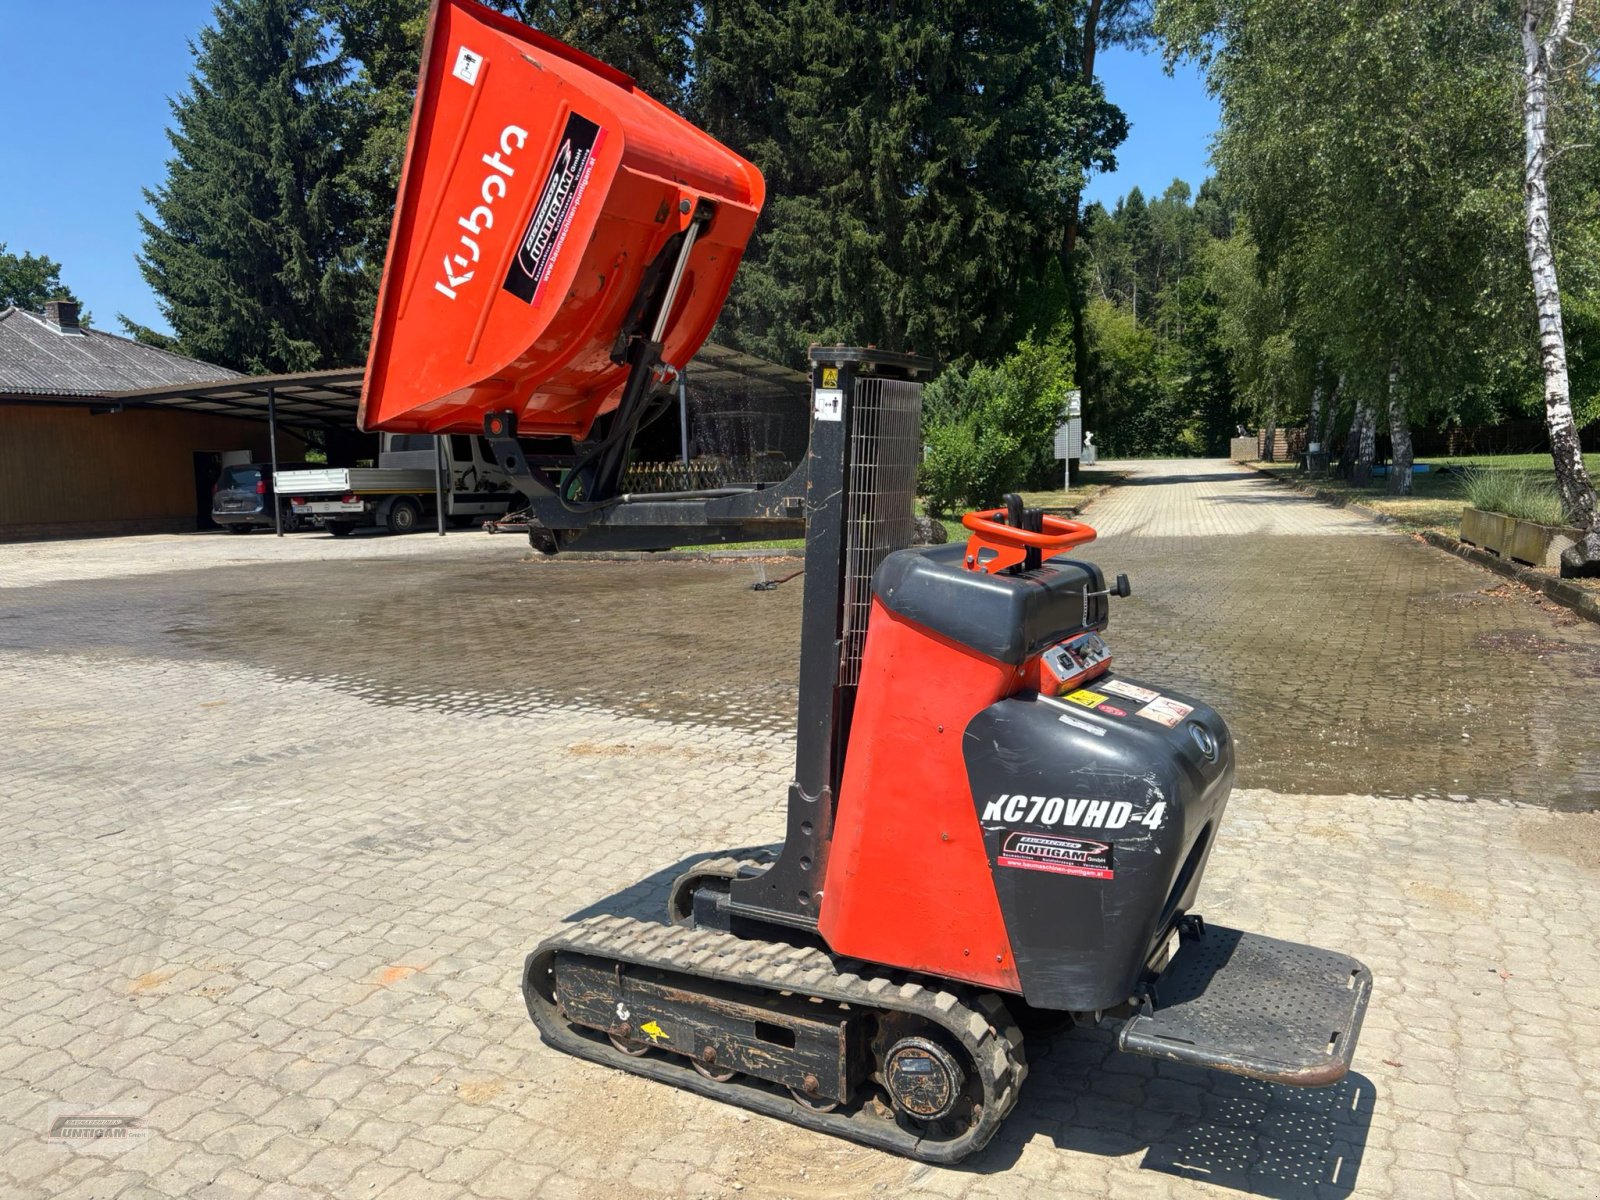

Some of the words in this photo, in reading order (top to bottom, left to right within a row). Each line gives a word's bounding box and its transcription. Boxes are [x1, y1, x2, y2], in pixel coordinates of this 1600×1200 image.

[570, 149, 582, 172] GmbH
[434, 124, 529, 300] Kubota
[543, 157, 596, 282] www.baumaschinen-puntigam.at
[981, 794, 1167, 830] KC70VHD-4
